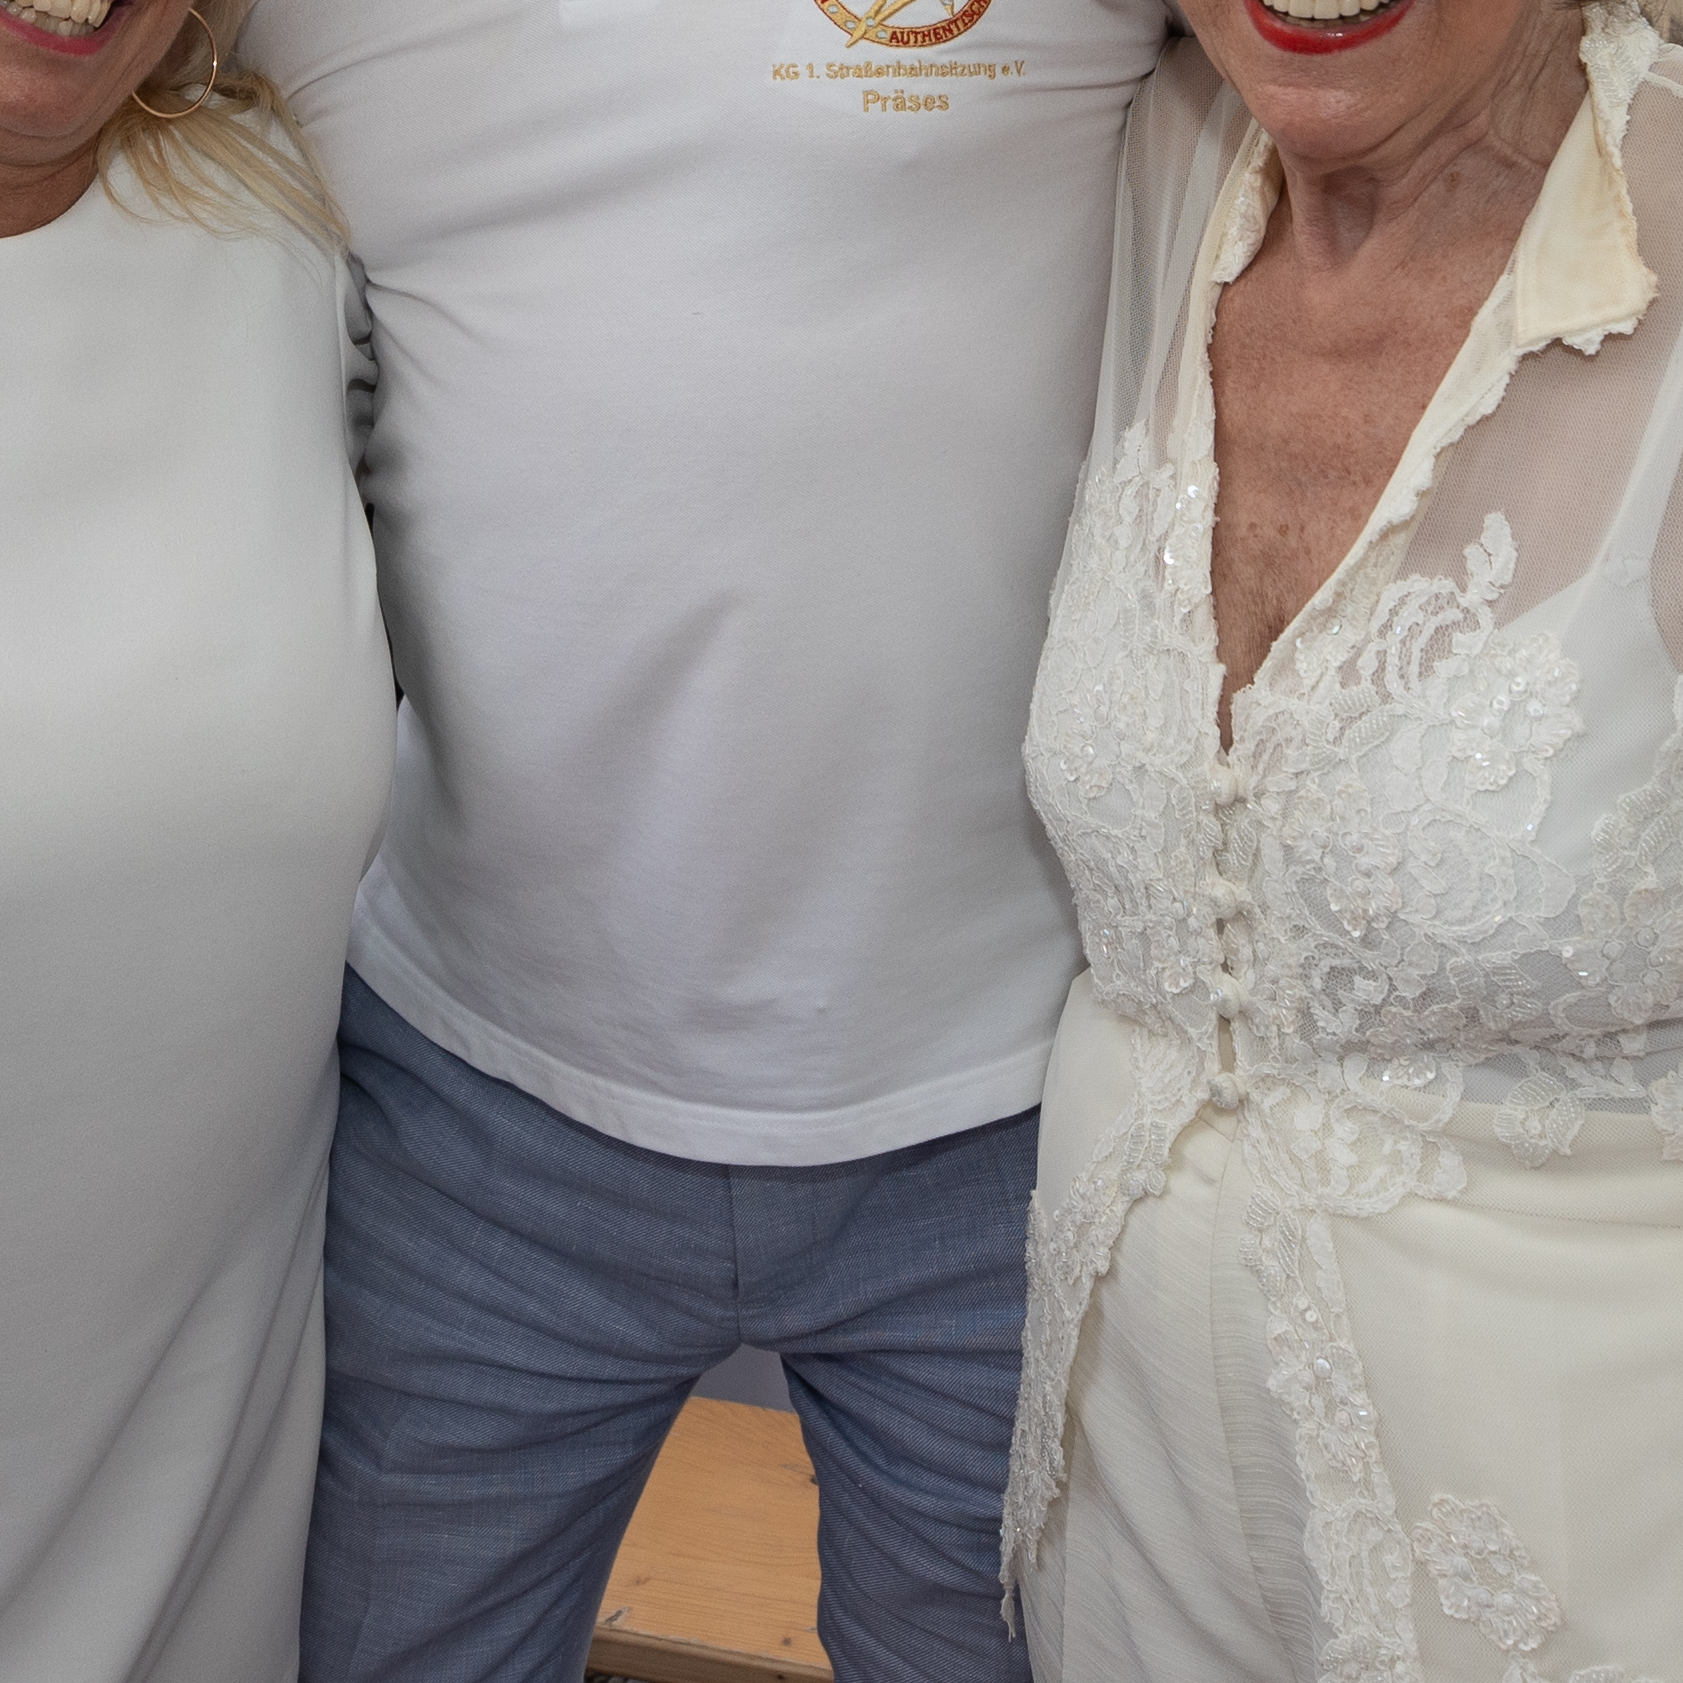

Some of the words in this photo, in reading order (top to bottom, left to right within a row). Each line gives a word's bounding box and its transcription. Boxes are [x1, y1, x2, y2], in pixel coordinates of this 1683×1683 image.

[772, 63, 799, 80] KG
[807, 62, 820, 80] 1.
[825, 59, 996, 80] Straßenbahnsitzung
[1001, 59, 1026, 77] e.V.
[862, 89, 950, 113] Präses
